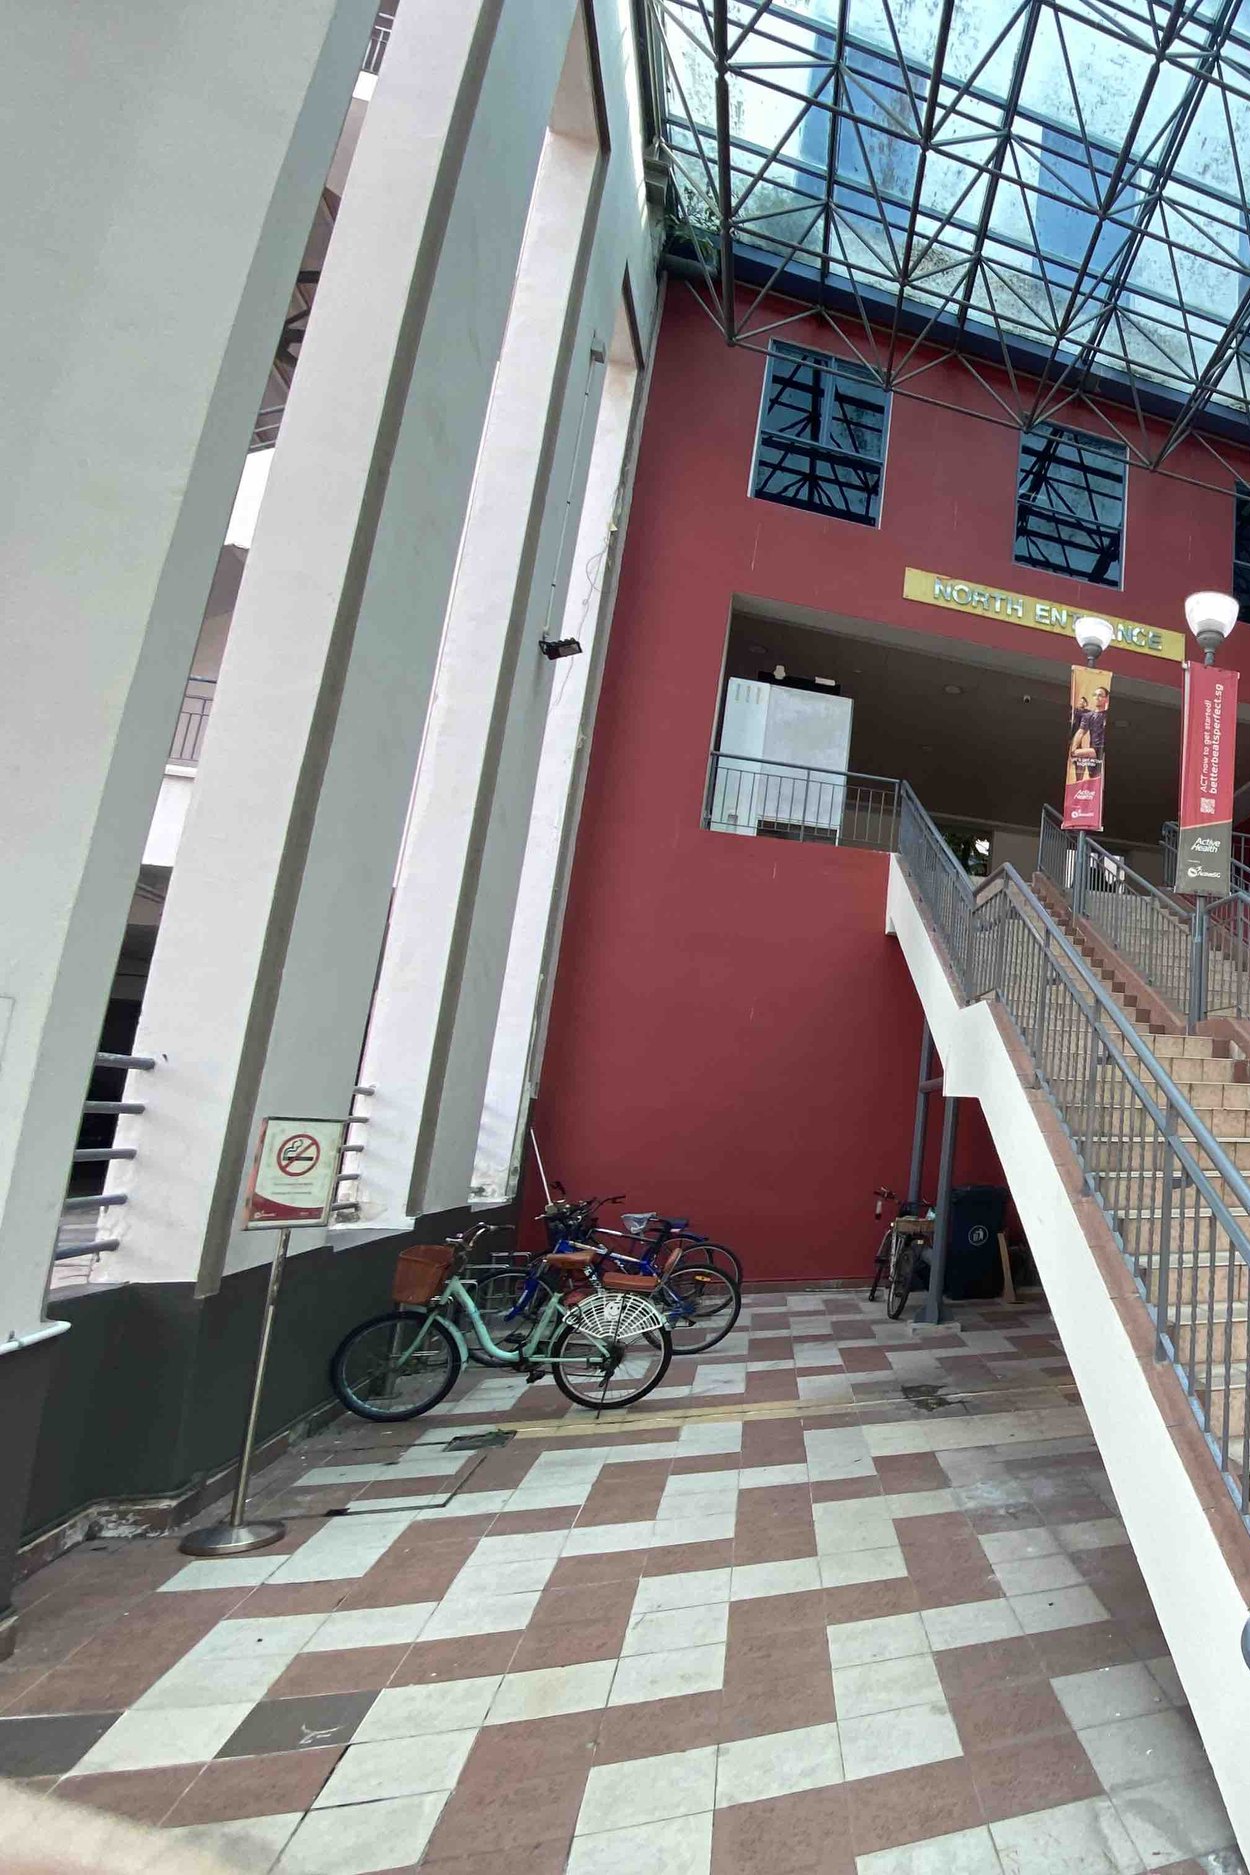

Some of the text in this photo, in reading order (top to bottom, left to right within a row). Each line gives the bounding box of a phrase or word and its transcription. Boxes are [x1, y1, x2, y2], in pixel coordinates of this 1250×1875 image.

[933, 576, 1163, 651] NORTH ENTNCE
[1203, 731, 1212, 745] get
[1209, 683, 1224, 794] betterbeatsperfect.sg
[1203, 746, 1210, 755] to
[1200, 773, 1209, 793] ACT
[1191, 843, 1218, 853] Health
[1193, 837, 1221, 848] Active
